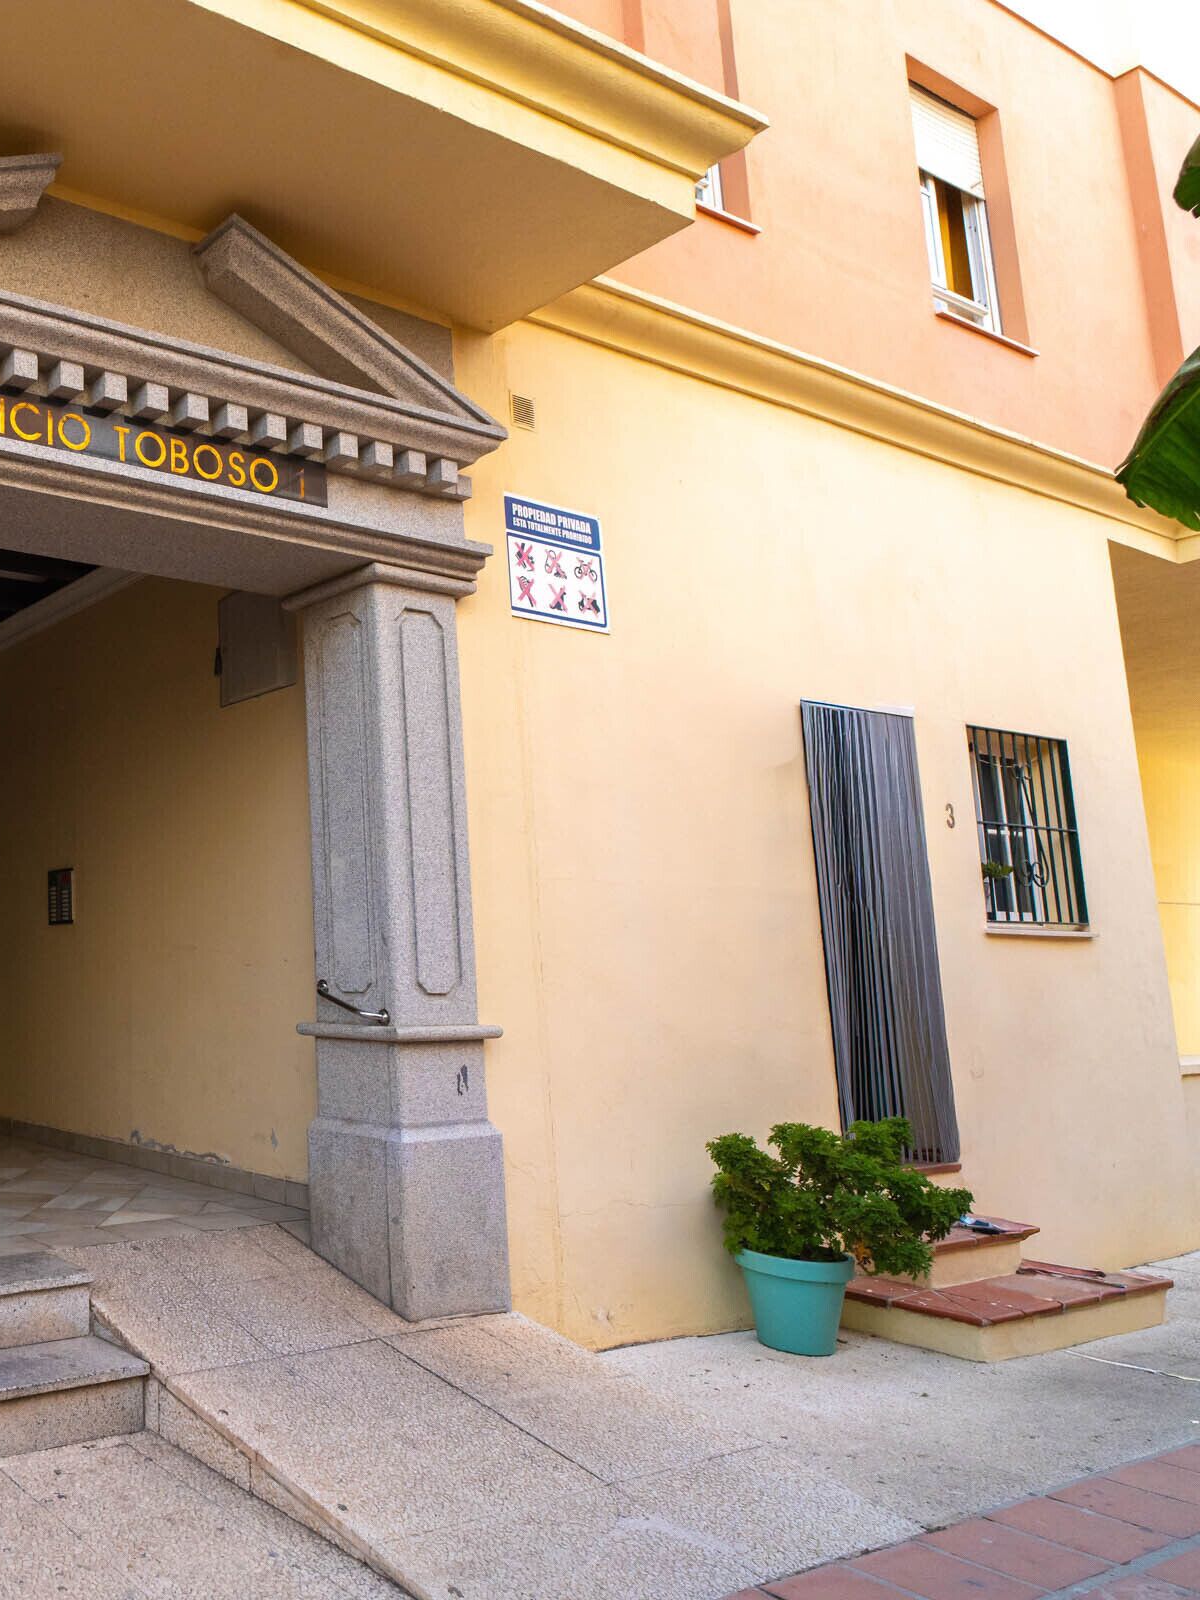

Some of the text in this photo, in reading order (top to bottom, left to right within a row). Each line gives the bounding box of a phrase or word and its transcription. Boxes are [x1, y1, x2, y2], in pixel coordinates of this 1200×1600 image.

[113, 426, 279, 492] TOBOSO
[512, 503, 592, 534] PROPIEDAD PRIVADA
[527, 520, 562, 537] TOTALMENTE
[945, 803, 955, 829] 3
